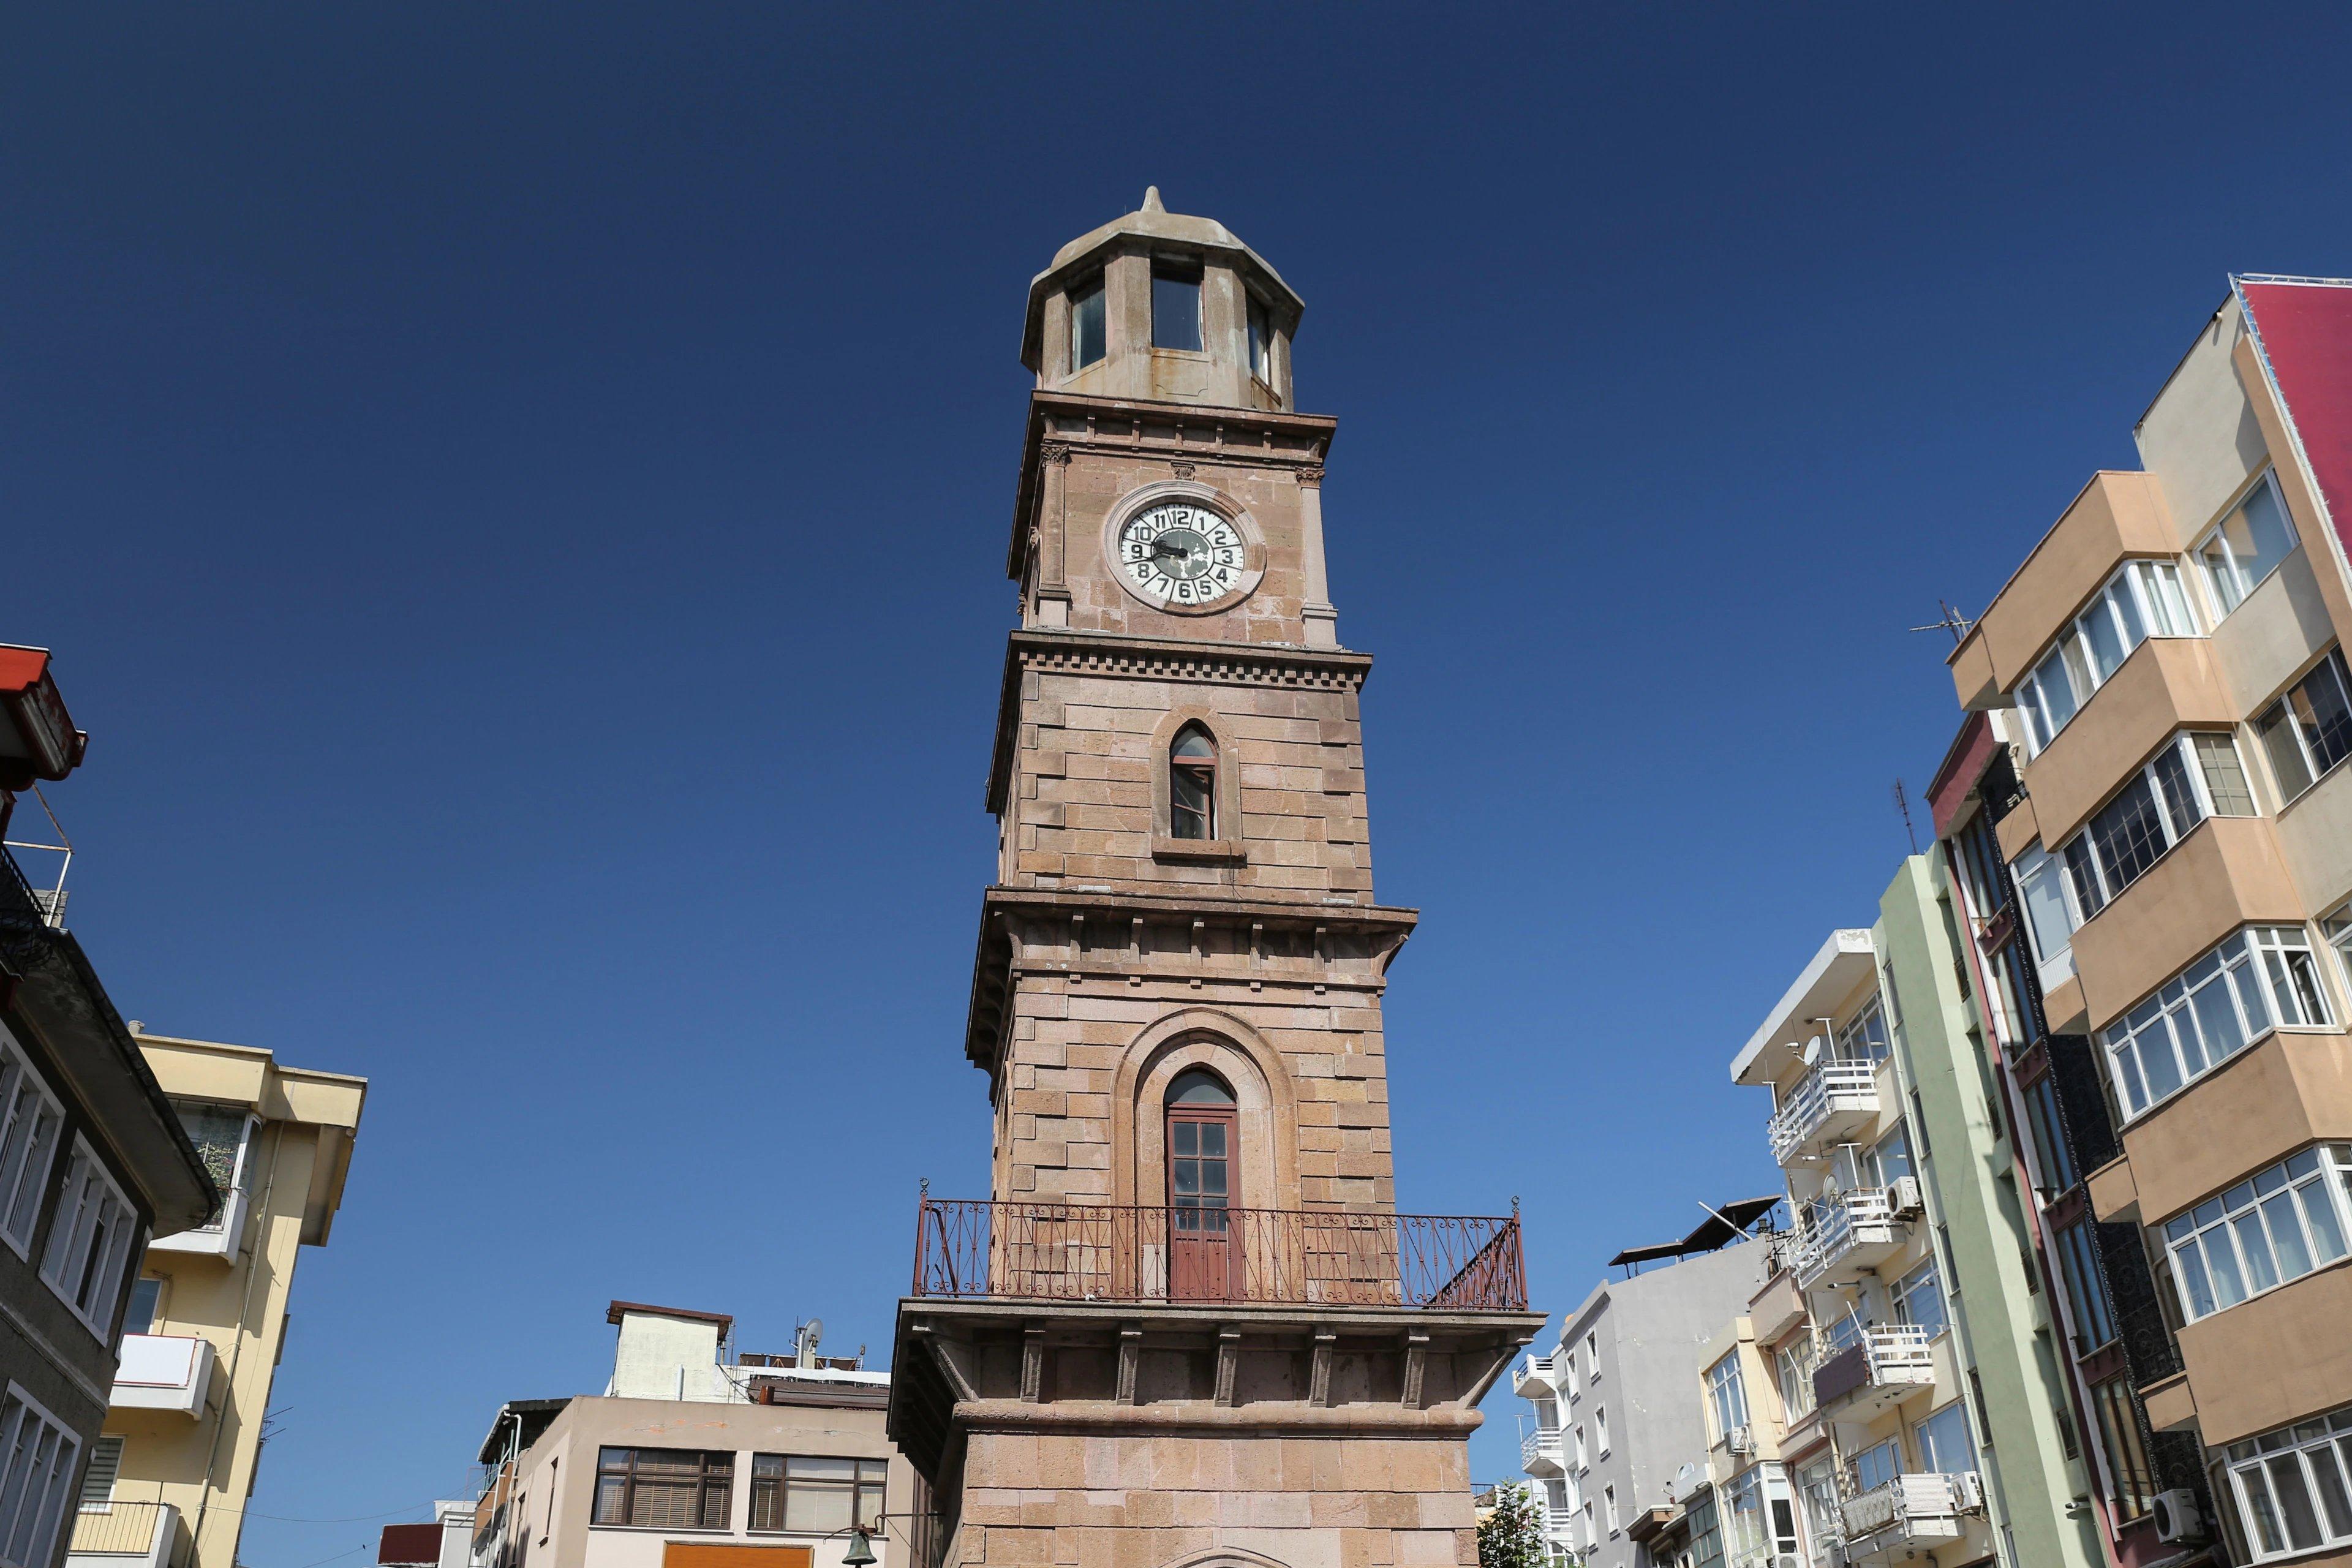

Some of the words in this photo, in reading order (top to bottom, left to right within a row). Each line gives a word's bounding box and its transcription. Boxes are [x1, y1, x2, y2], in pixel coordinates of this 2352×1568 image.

[1154, 514, 1166, 529] 11
[1171, 510, 1189, 525] 12
[1199, 516, 1205, 530] 1
[1134, 526, 1151, 541] 10
[1215, 530, 1227, 545] 2
[1131, 545, 1143, 559] 9
[1221, 549, 1234, 564] 3
[1137, 564, 1150, 578] 8
[1216, 568, 1228, 582] 4
[1158, 578, 1169, 593] 7
[1178, 583, 1191, 598] 6
[1199, 580, 1212, 595] 5
